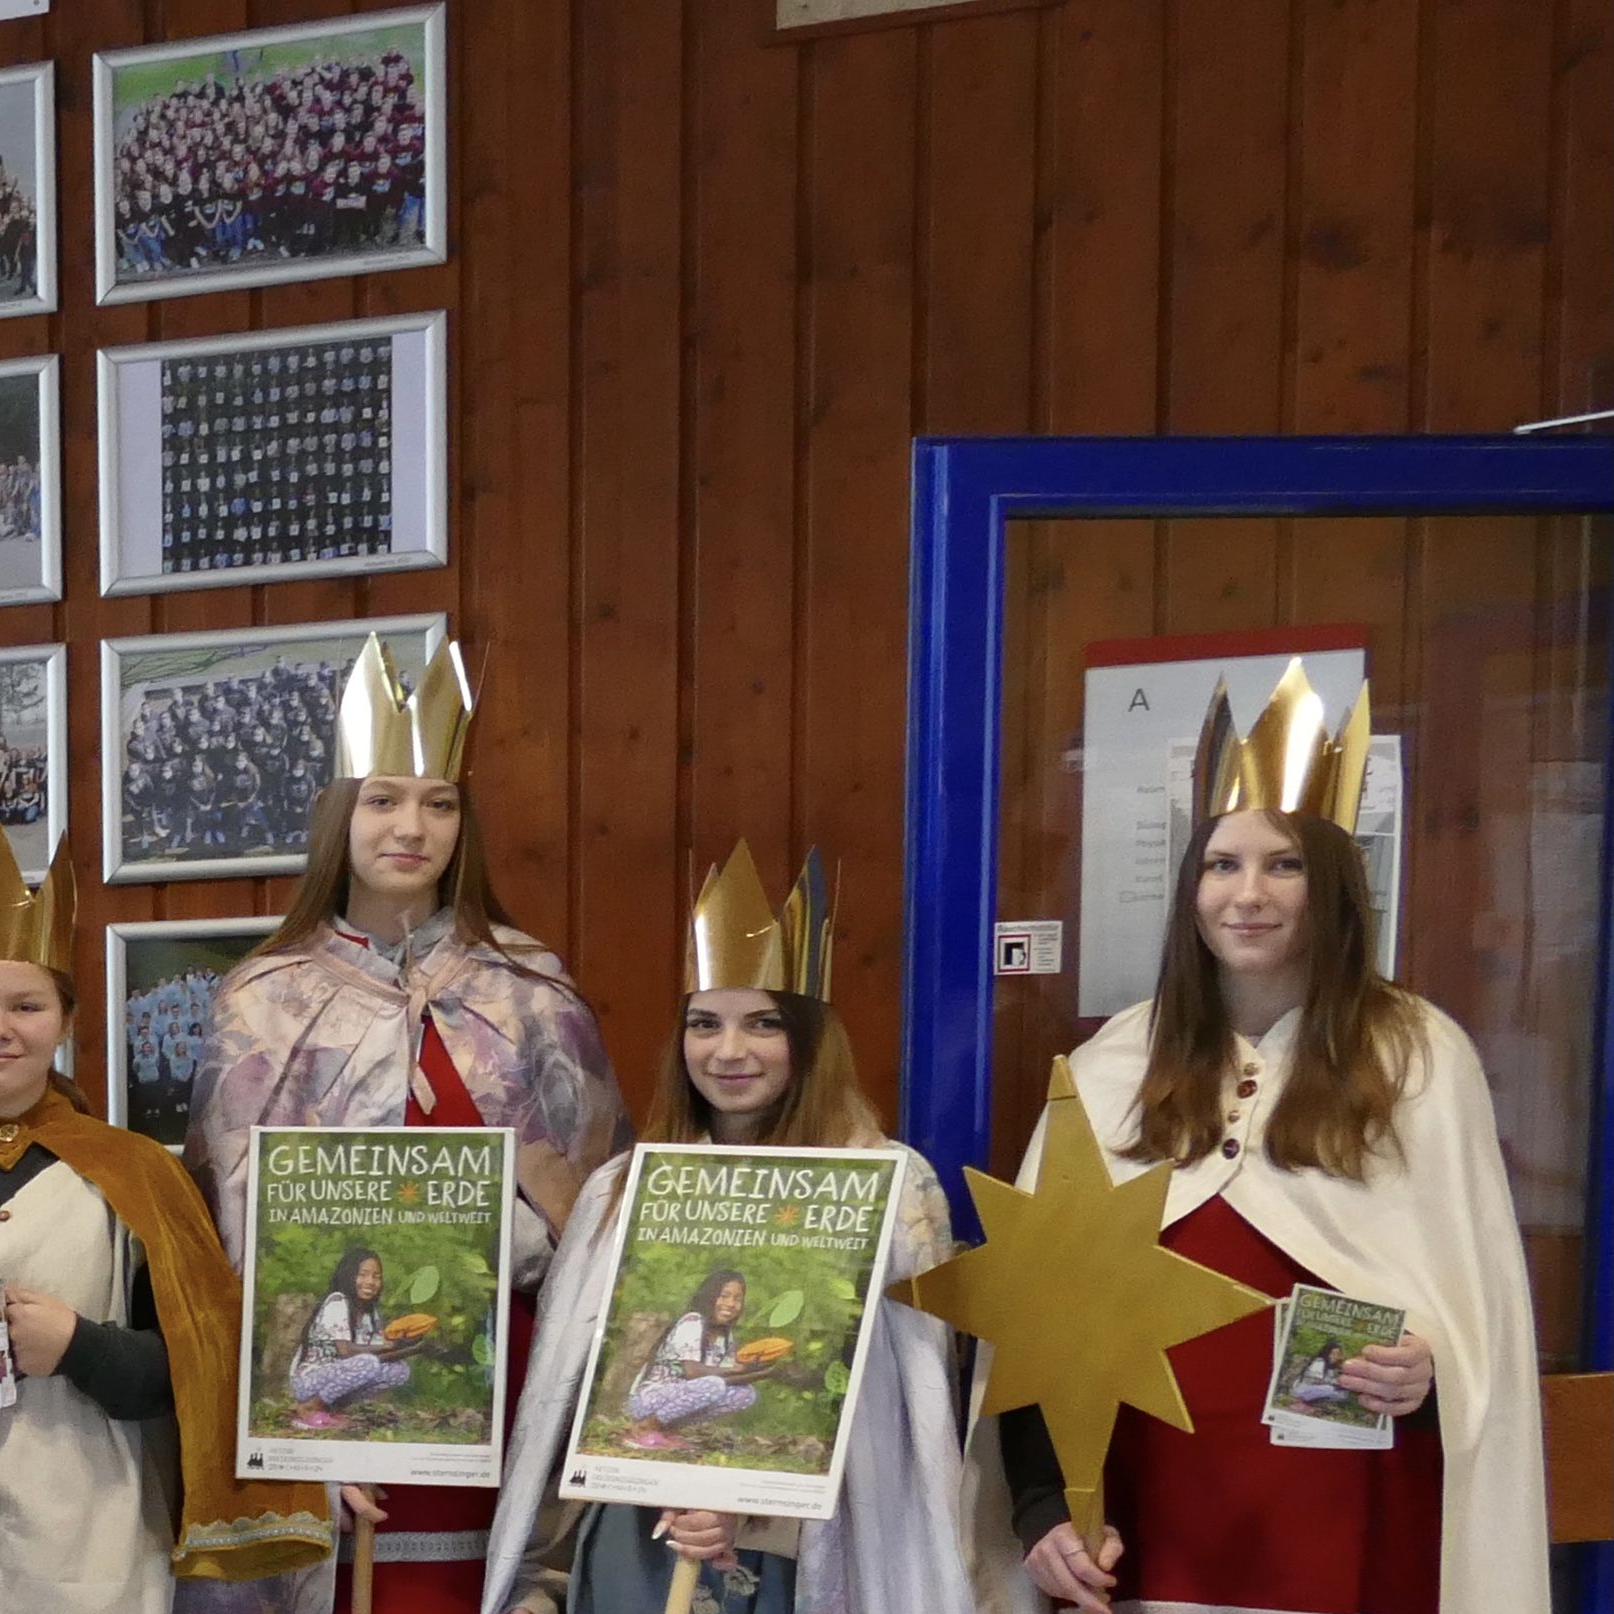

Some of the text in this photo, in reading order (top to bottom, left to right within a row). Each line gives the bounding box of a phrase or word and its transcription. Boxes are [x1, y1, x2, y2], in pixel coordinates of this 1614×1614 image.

[1128, 688, 1150, 712] A
[268, 1144, 491, 1178] GEMEINSAM
[267, 1179, 491, 1208] FÜR UNSERE ERDE
[647, 1163, 880, 1203] GEMEINSAM
[269, 1207, 492, 1225] IN AMAZONIEN UND WELTWEIT
[640, 1198, 874, 1233] FÜR UNSERE ERDE
[637, 1226, 869, 1251] IN AMAZONIEN UND WELTWEIT
[1300, 1293, 1401, 1326] GEMEINSAM
